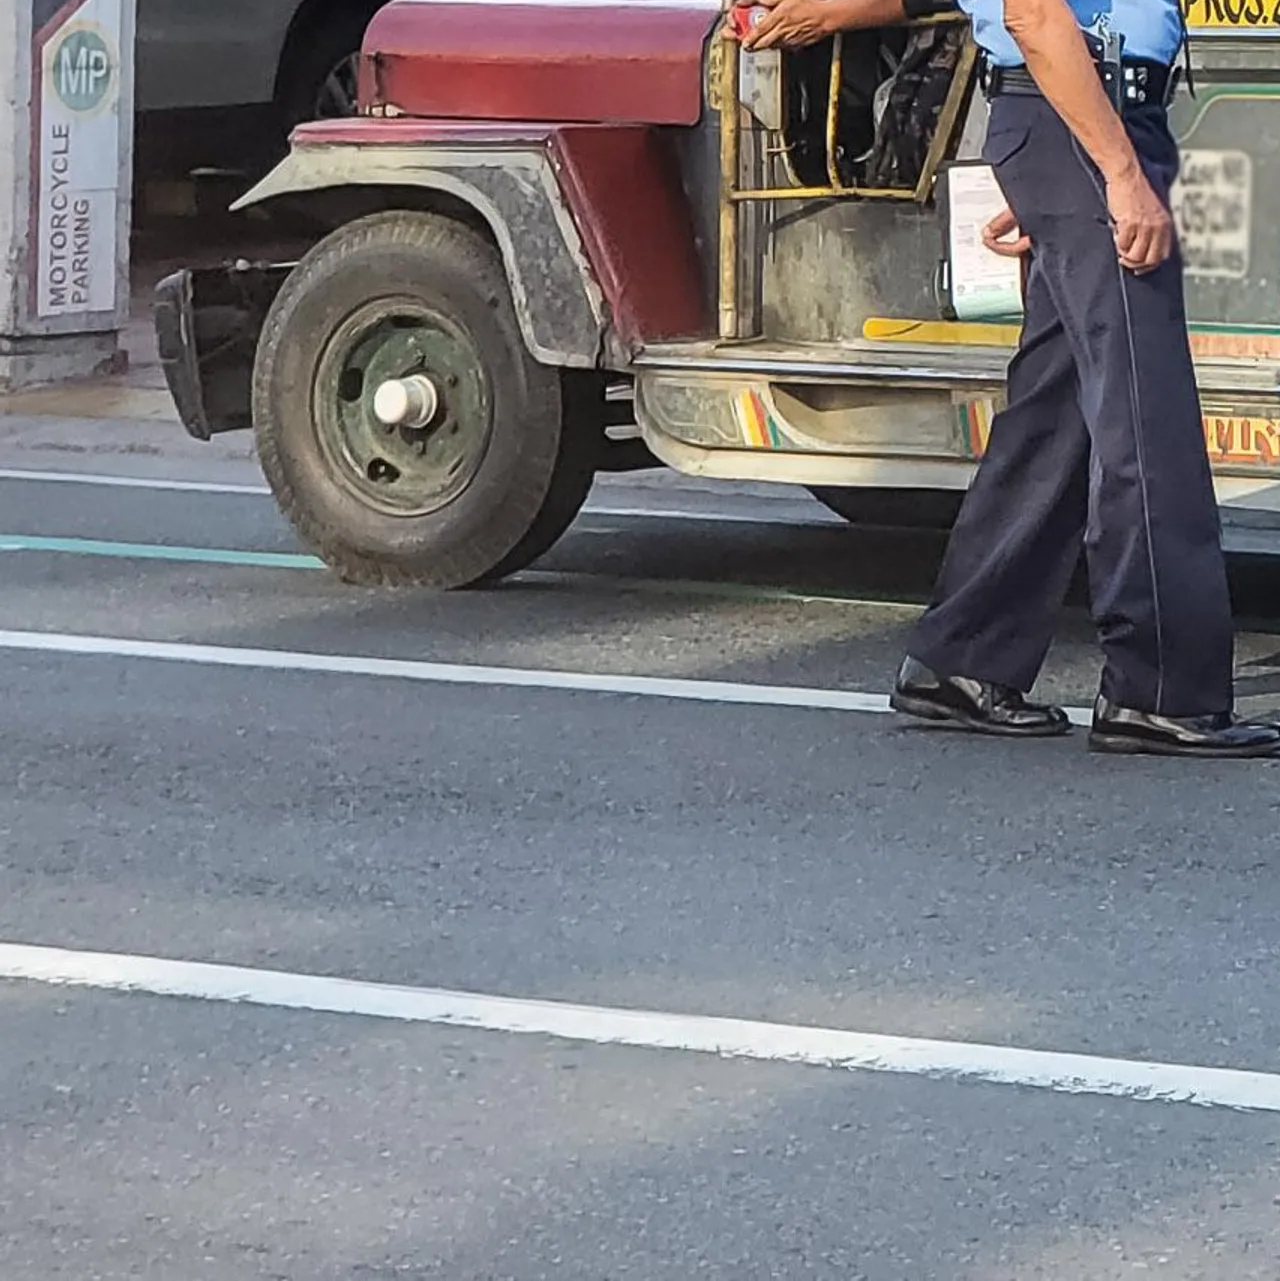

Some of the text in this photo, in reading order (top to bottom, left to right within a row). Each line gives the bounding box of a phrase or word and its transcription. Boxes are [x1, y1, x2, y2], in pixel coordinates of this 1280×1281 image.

[59, 45, 107, 96] MP
[49, 123, 70, 307] MOTORCYCLE
[71, 198, 90, 305] PARKING
